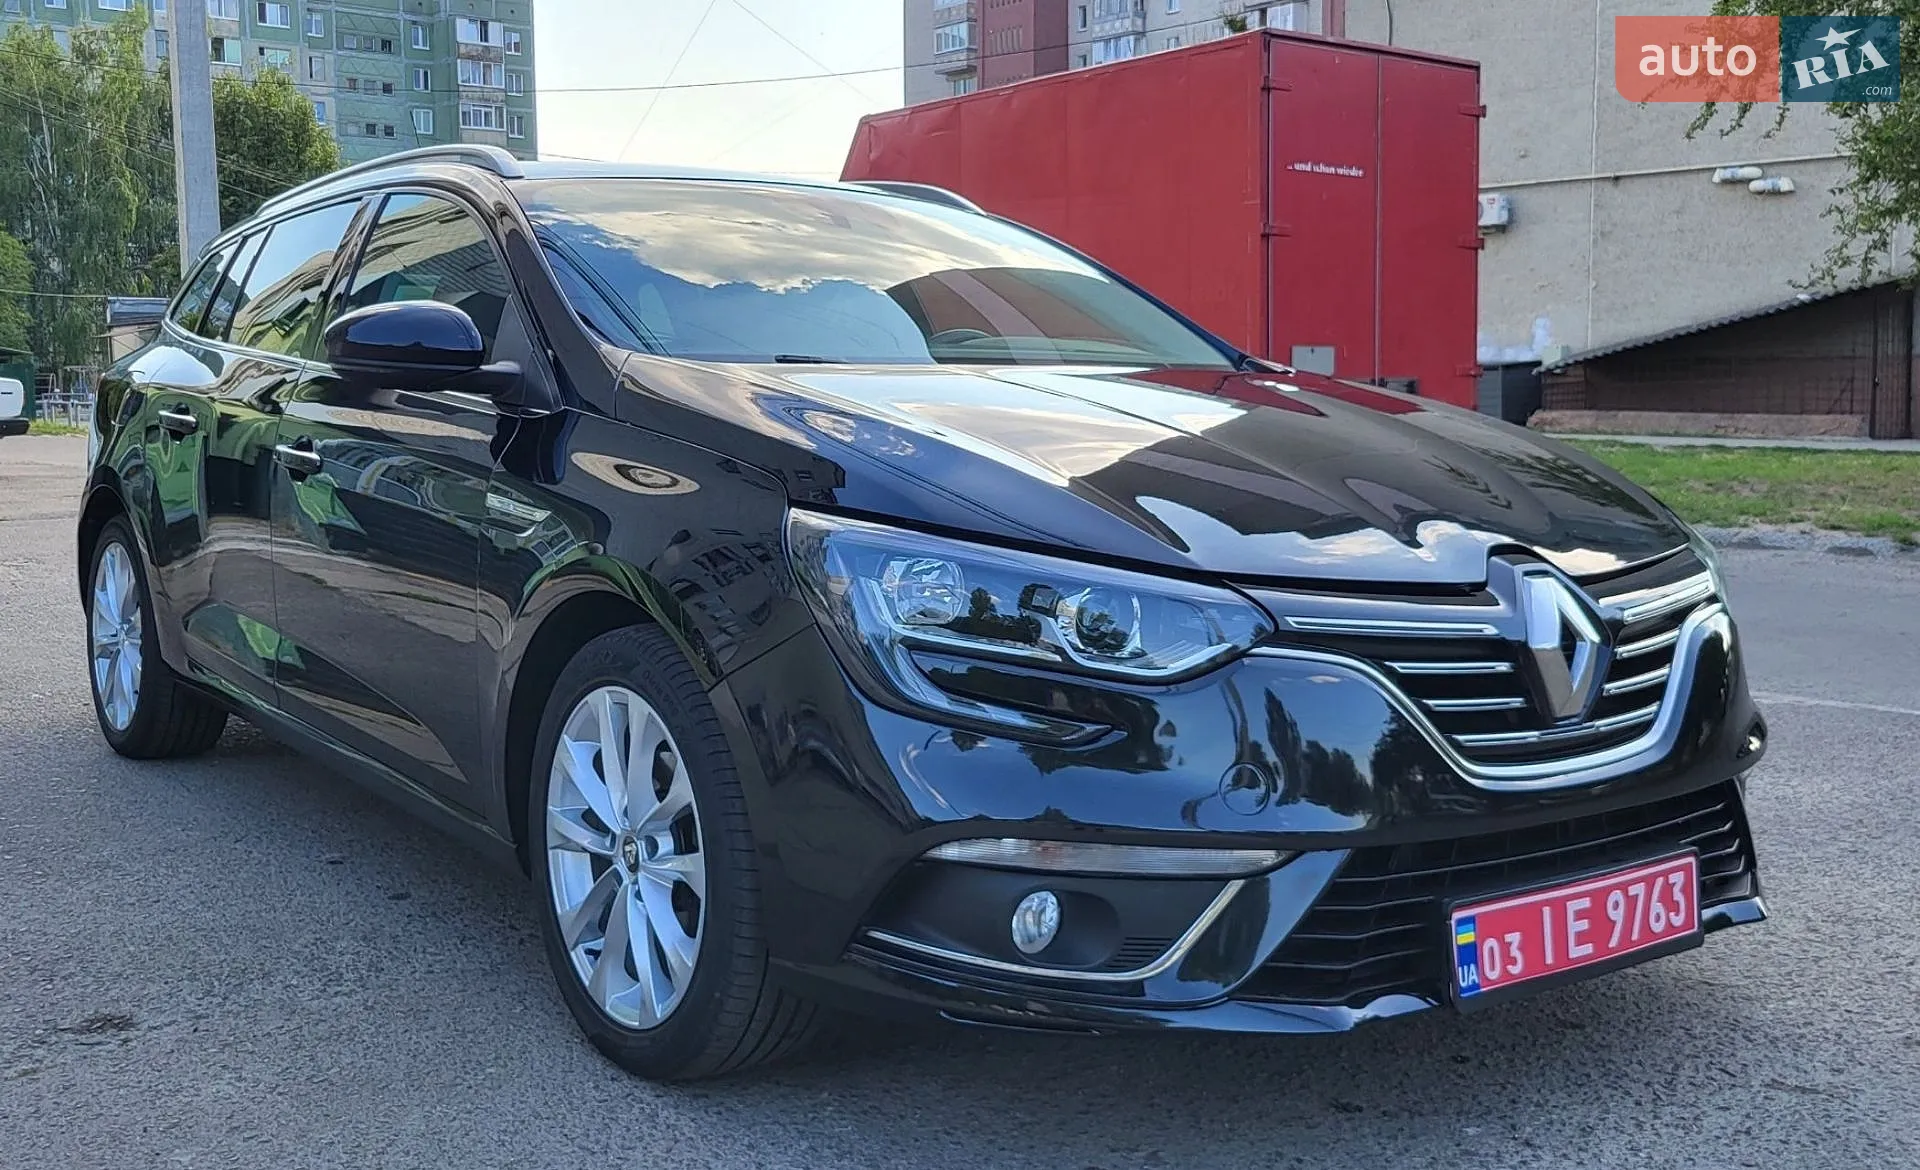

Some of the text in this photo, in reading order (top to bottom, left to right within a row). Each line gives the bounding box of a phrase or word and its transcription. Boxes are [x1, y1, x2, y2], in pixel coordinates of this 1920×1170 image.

[1482, 870, 1686, 980] 03 IE 9763
[1458, 965, 1479, 987] UA
